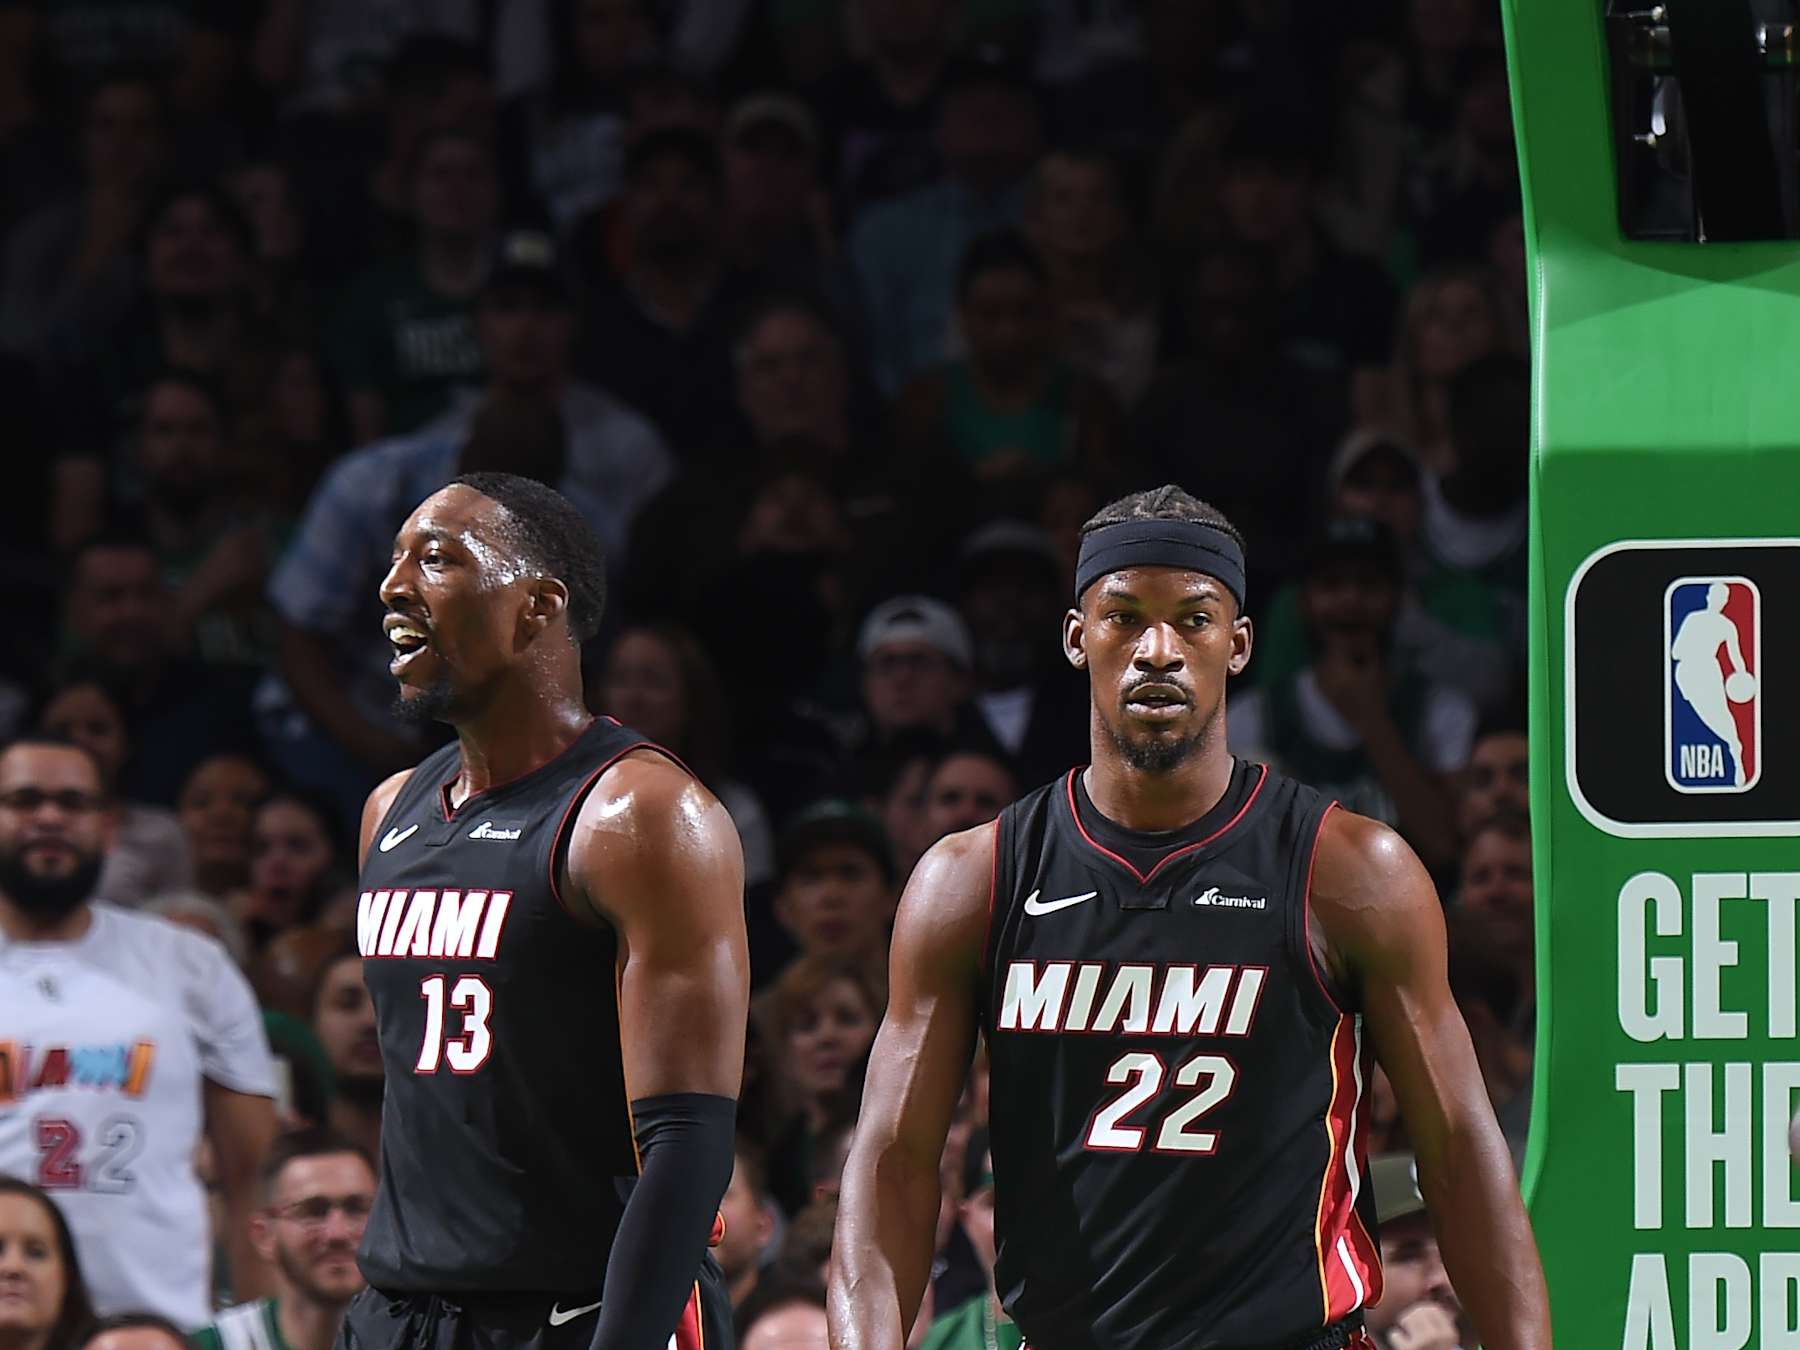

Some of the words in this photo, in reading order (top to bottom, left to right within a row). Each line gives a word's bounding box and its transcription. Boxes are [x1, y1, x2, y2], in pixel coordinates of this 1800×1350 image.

[1680, 744, 1725, 778] NBA
[357, 887, 514, 960] MIAMI
[1211, 894, 1267, 910] Carnival
[1616, 871, 1800, 1043] GET
[414, 973, 493, 1074] 13
[997, 960, 1270, 1038] MIAMI
[1083, 1051, 1240, 1155] 22
[33, 1114, 146, 1195] 22
[1615, 1062, 1800, 1230] THE
